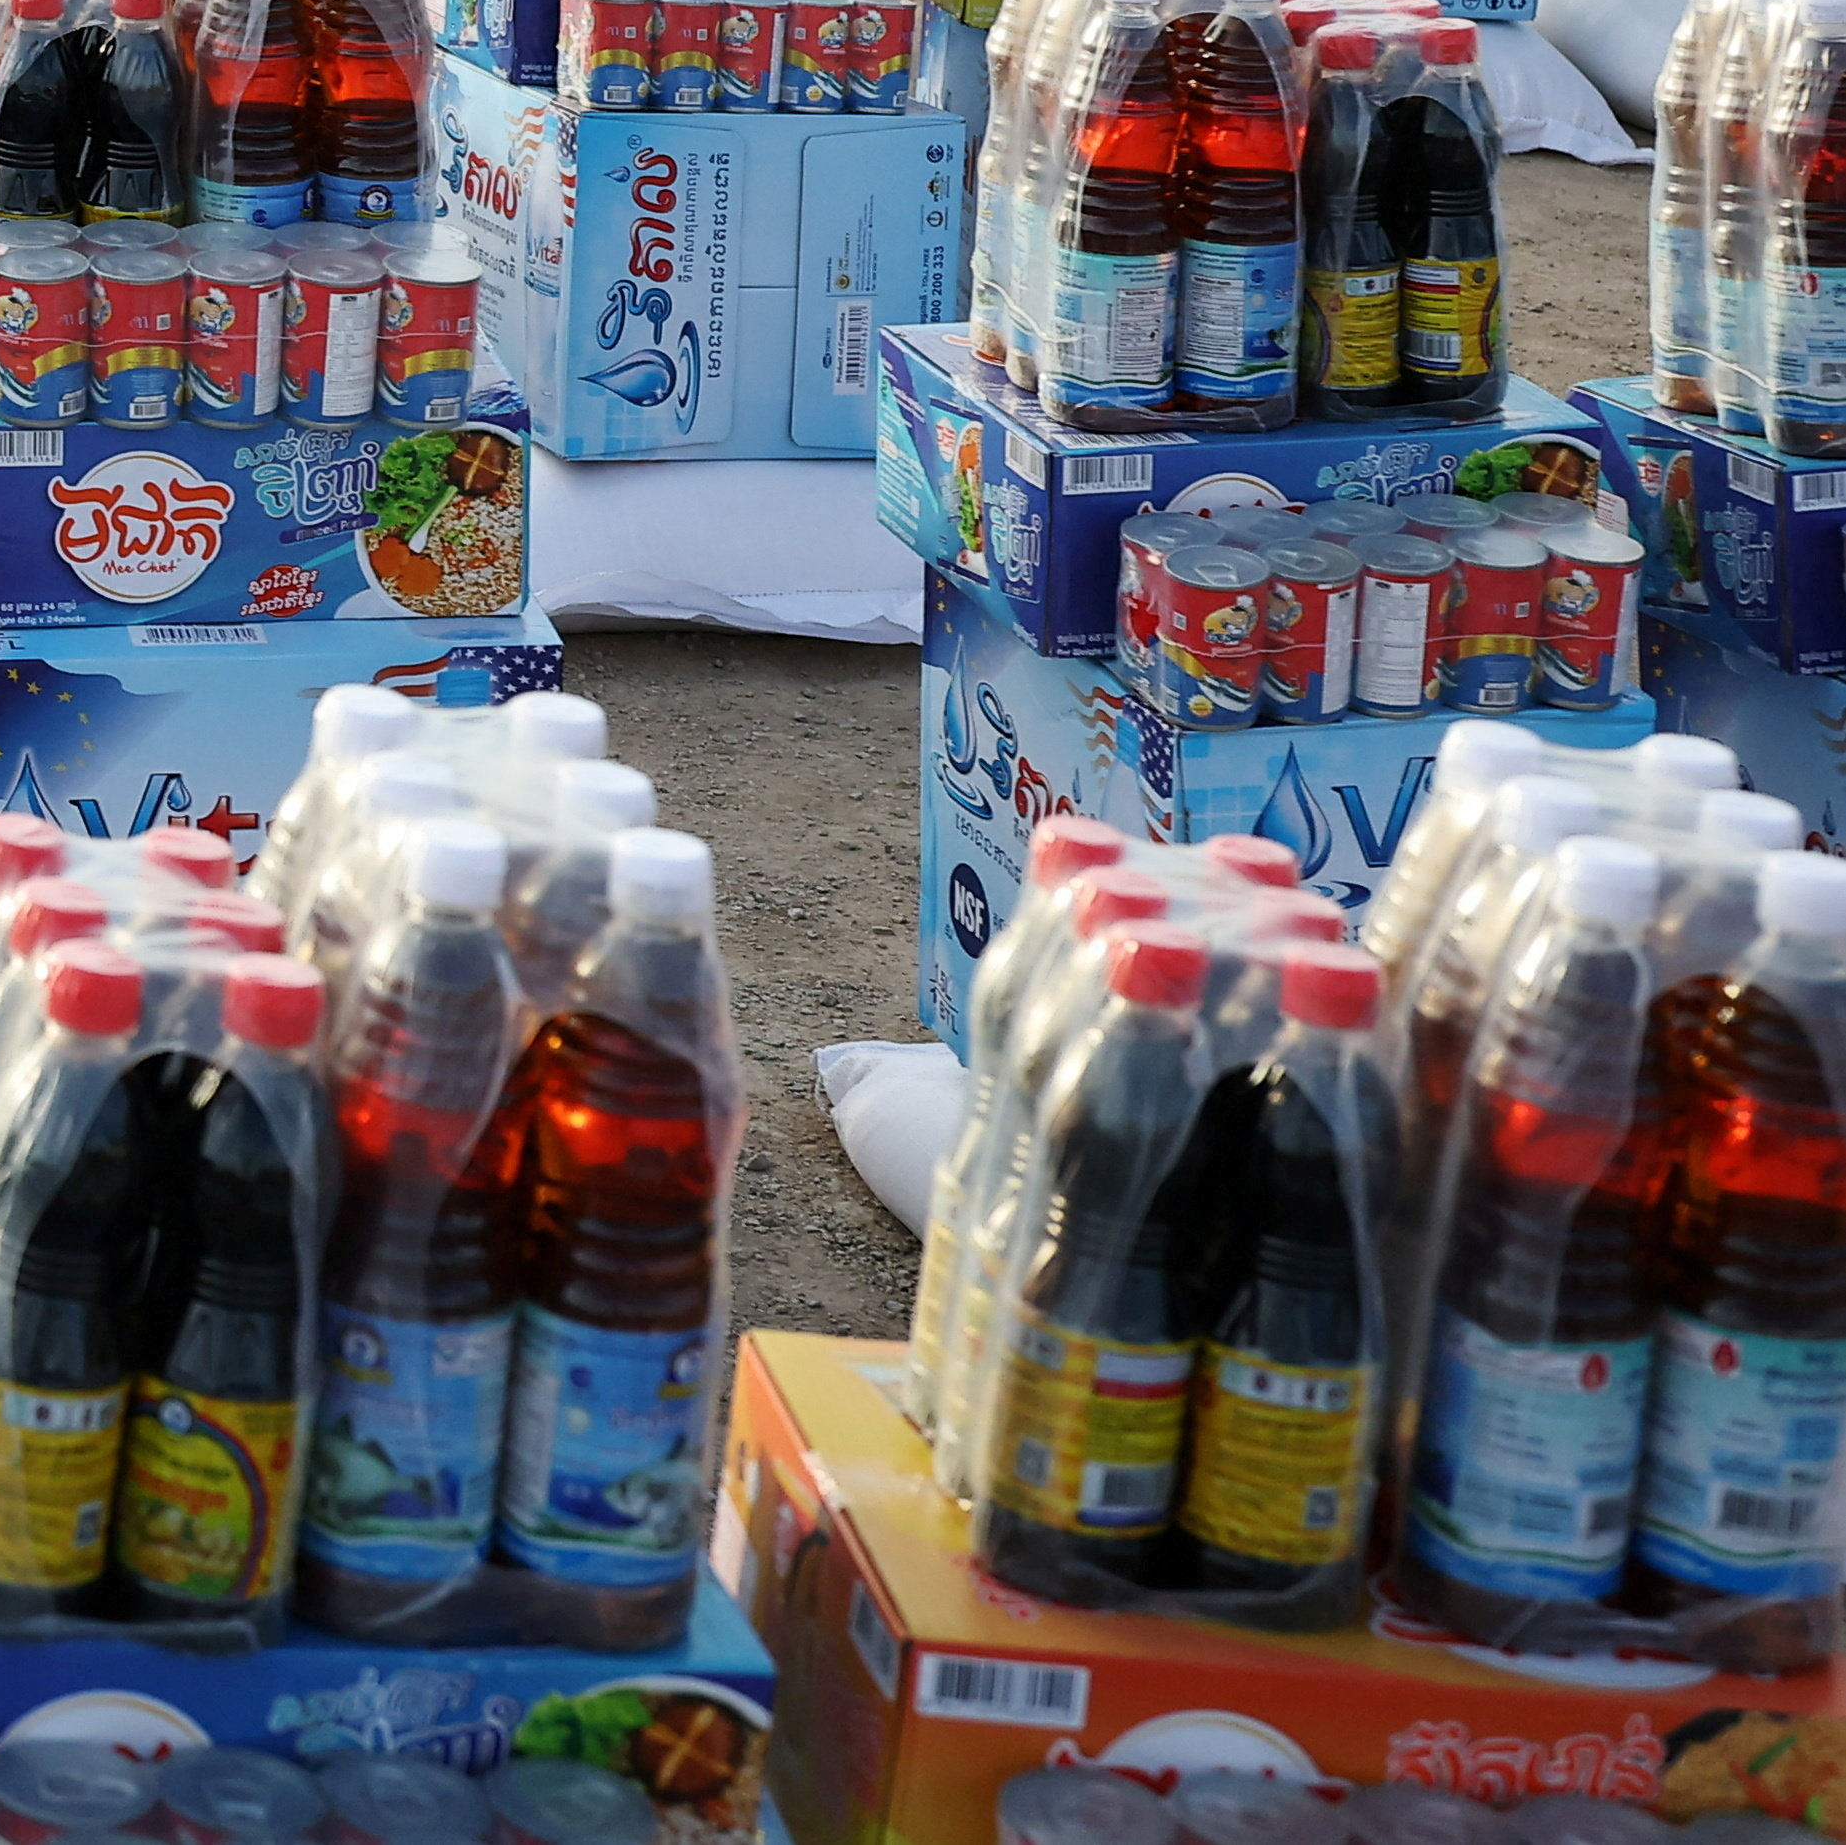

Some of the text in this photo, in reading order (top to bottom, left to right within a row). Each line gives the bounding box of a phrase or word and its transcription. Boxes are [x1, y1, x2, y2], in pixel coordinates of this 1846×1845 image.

[931, 245, 945, 323] 800 200 333
[103, 559, 132, 574] Mee
